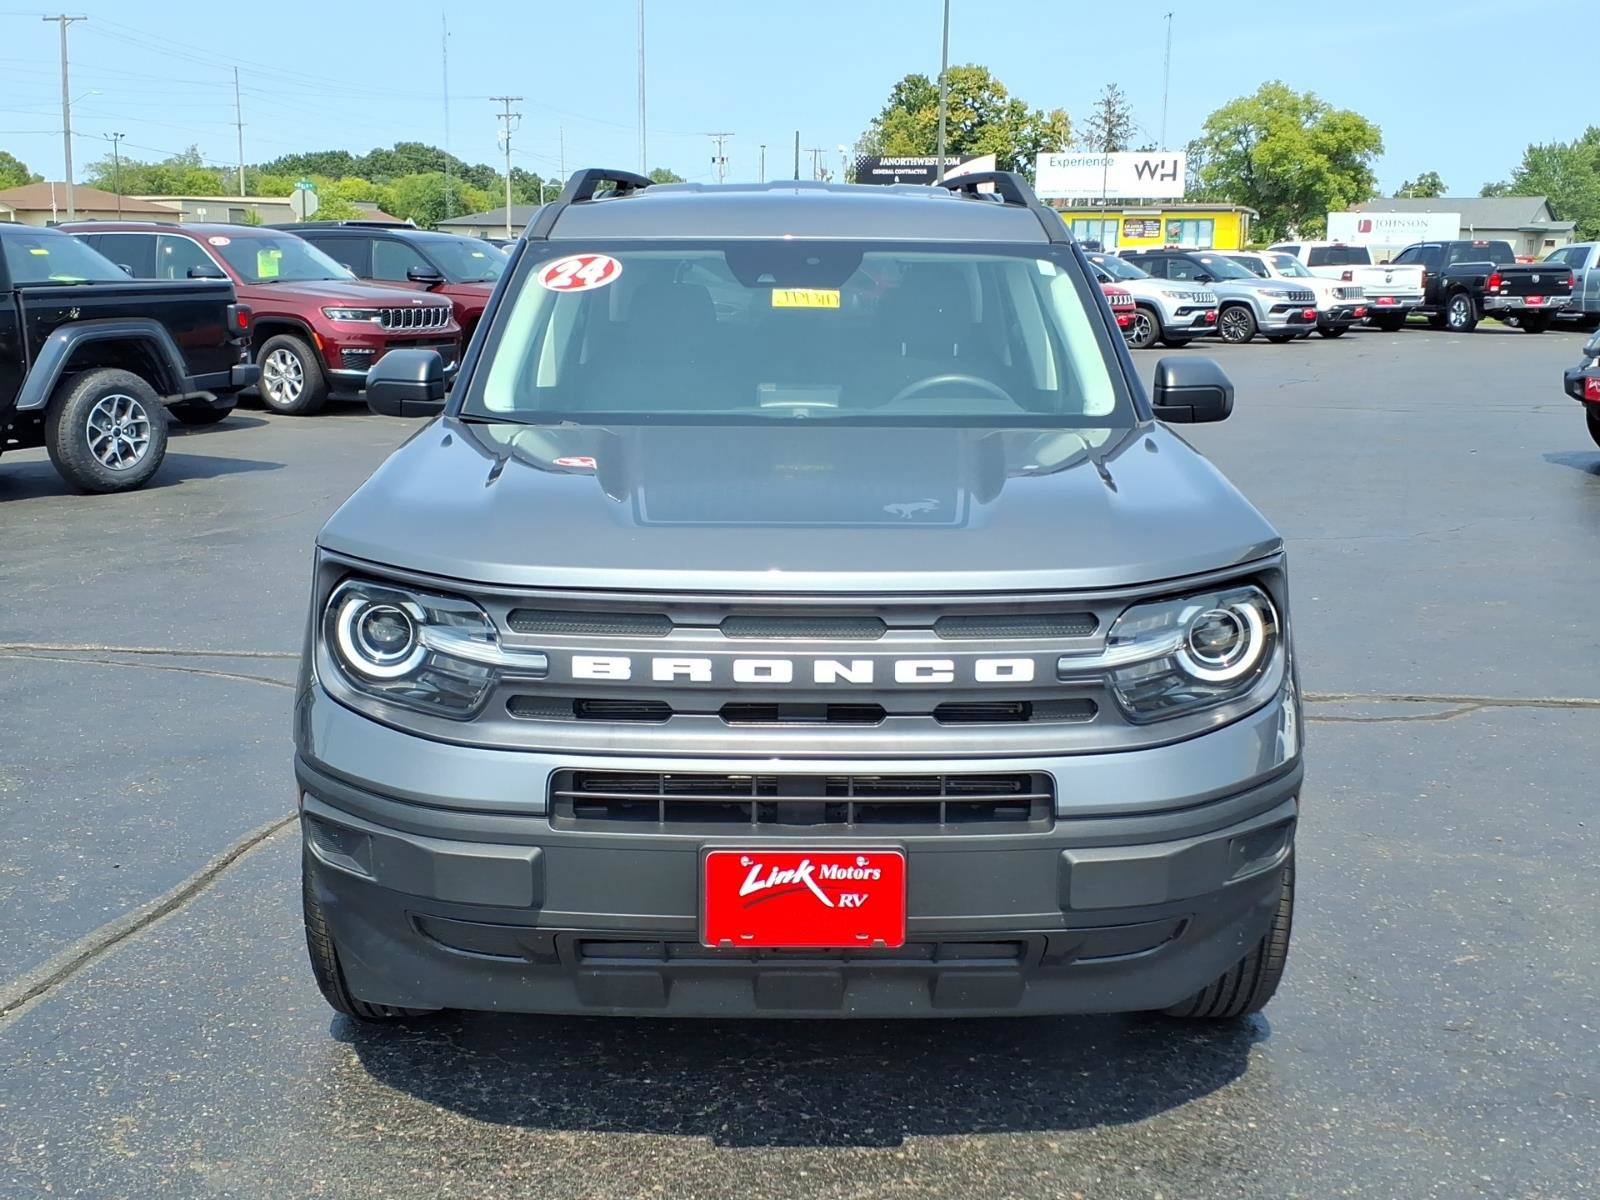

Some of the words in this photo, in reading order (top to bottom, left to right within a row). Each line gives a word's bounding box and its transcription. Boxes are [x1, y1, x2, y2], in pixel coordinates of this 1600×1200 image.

[879, 157, 961, 166] JANORTHWESTCOM
[1050, 156, 1114, 168] Experience
[1376, 219, 1429, 230] JOHNSON
[545, 257, 613, 289] 24
[571, 655, 1035, 684] BRONCO
[739, 859, 835, 908] Link
[819, 864, 881, 880] Motors
[838, 893, 869, 908] RV
